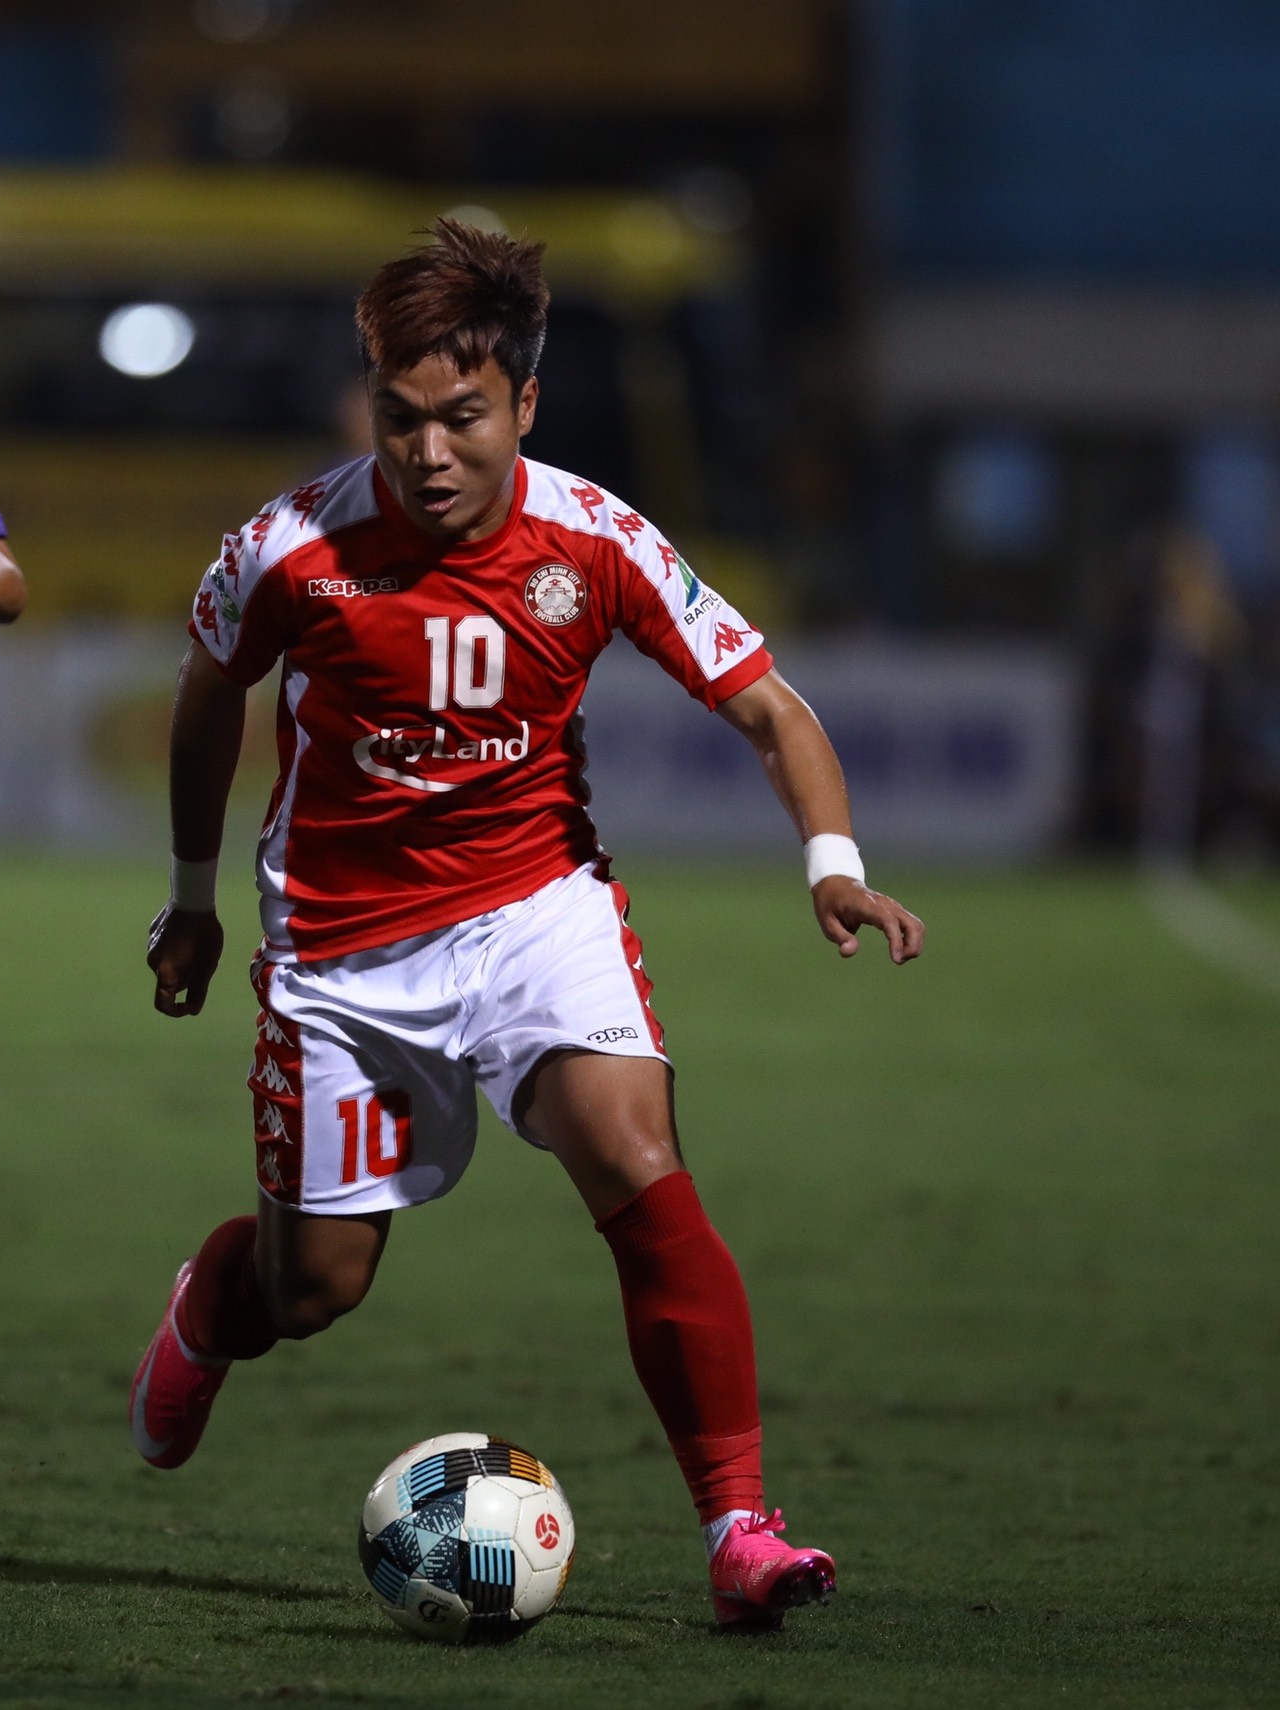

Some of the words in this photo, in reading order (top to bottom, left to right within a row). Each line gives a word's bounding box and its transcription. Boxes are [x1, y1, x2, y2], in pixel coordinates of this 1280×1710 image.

[308, 578, 399, 598] Kappa
[549, 566, 568, 577] MINH
[567, 572, 581, 585] CITY
[533, 608, 564, 624] FOOTBALL
[563, 606, 580, 620] CLUB
[424, 615, 507, 712] 10
[352, 720, 531, 793] CityLand
[336, 1087, 414, 1186] 10
